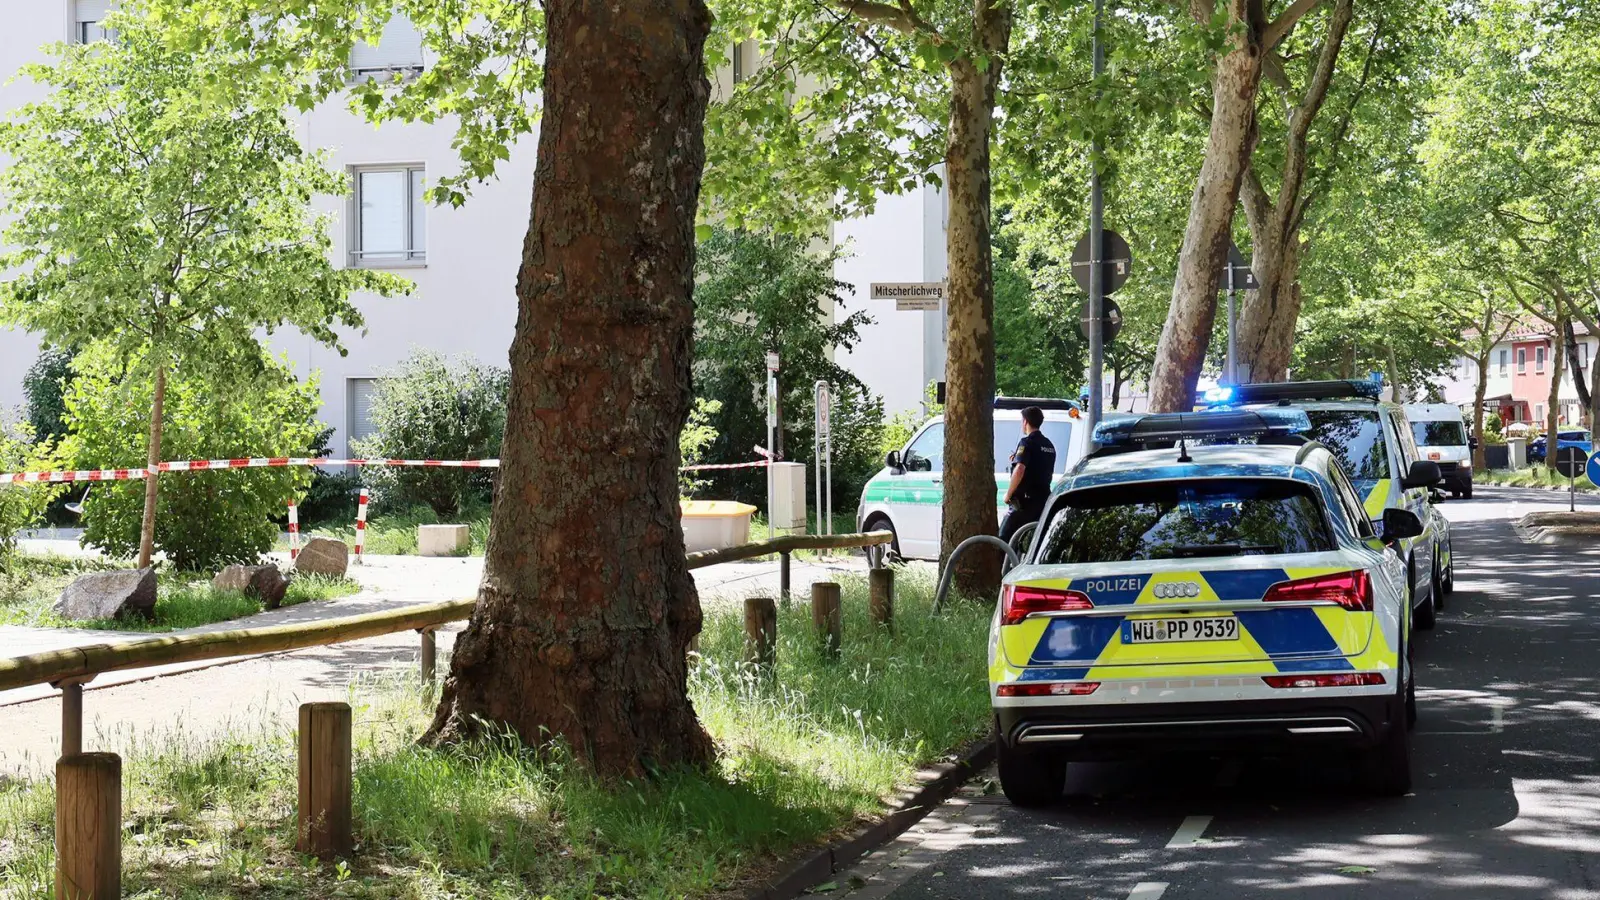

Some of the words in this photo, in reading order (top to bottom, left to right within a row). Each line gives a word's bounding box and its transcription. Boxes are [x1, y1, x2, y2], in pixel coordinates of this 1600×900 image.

[875, 285, 943, 298] Mitscherlichweg
[1086, 578, 1141, 593] POLIZEI
[1167, 620, 1189, 639] PP
[1193, 619, 1236, 638] 9539
